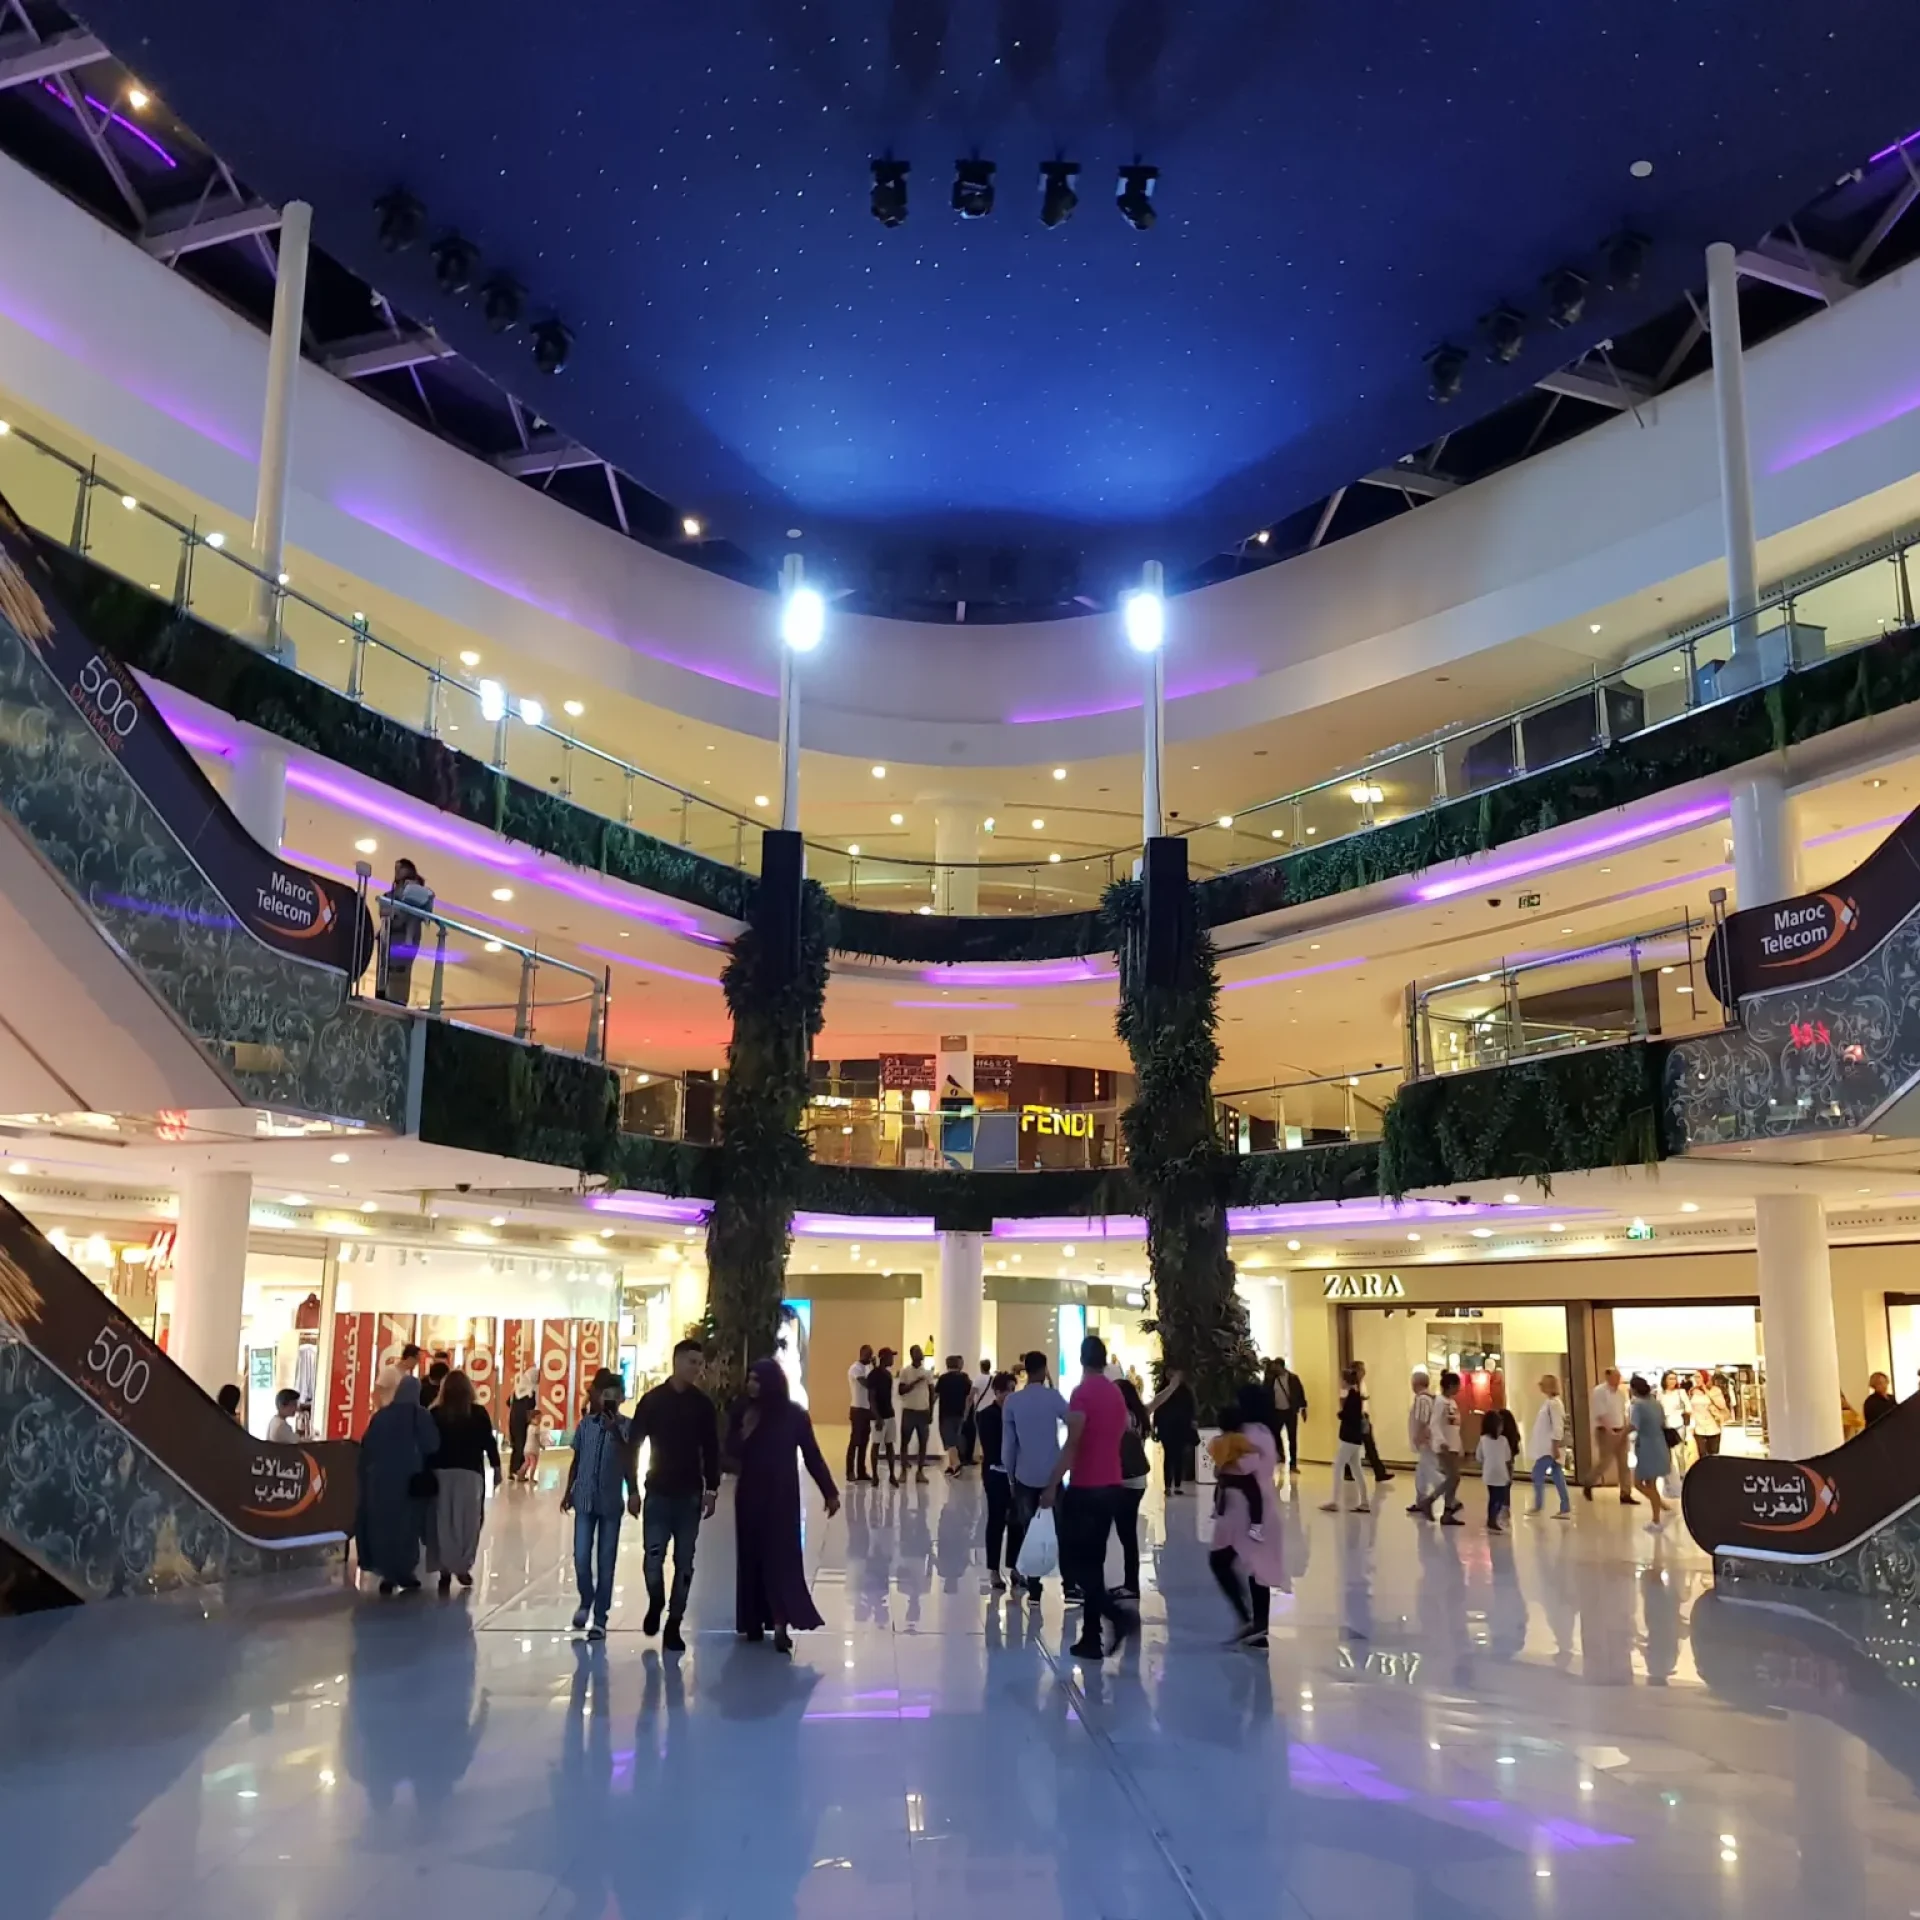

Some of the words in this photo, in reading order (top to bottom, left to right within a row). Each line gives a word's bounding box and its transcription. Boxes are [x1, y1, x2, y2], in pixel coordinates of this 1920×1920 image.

[80, 655, 138, 736] 500
[271, 871, 313, 905] Maroc
[257, 887, 311, 926] Telecom
[1774, 904, 1826, 931] Maroc
[1760, 926, 1828, 955] Telecom
[1021, 1104, 1094, 1139] FENDI
[1322, 1273, 1405, 1299] ZARA
[87, 1325, 150, 1404] 500
[541, 1319, 570, 1430] 70%
[251, 1455, 305, 1480] اتصالات
[254, 1480, 302, 1503] المغرب
[1743, 1474, 1806, 1493] اتصالات
[1752, 1495, 1809, 1518] المغرب
